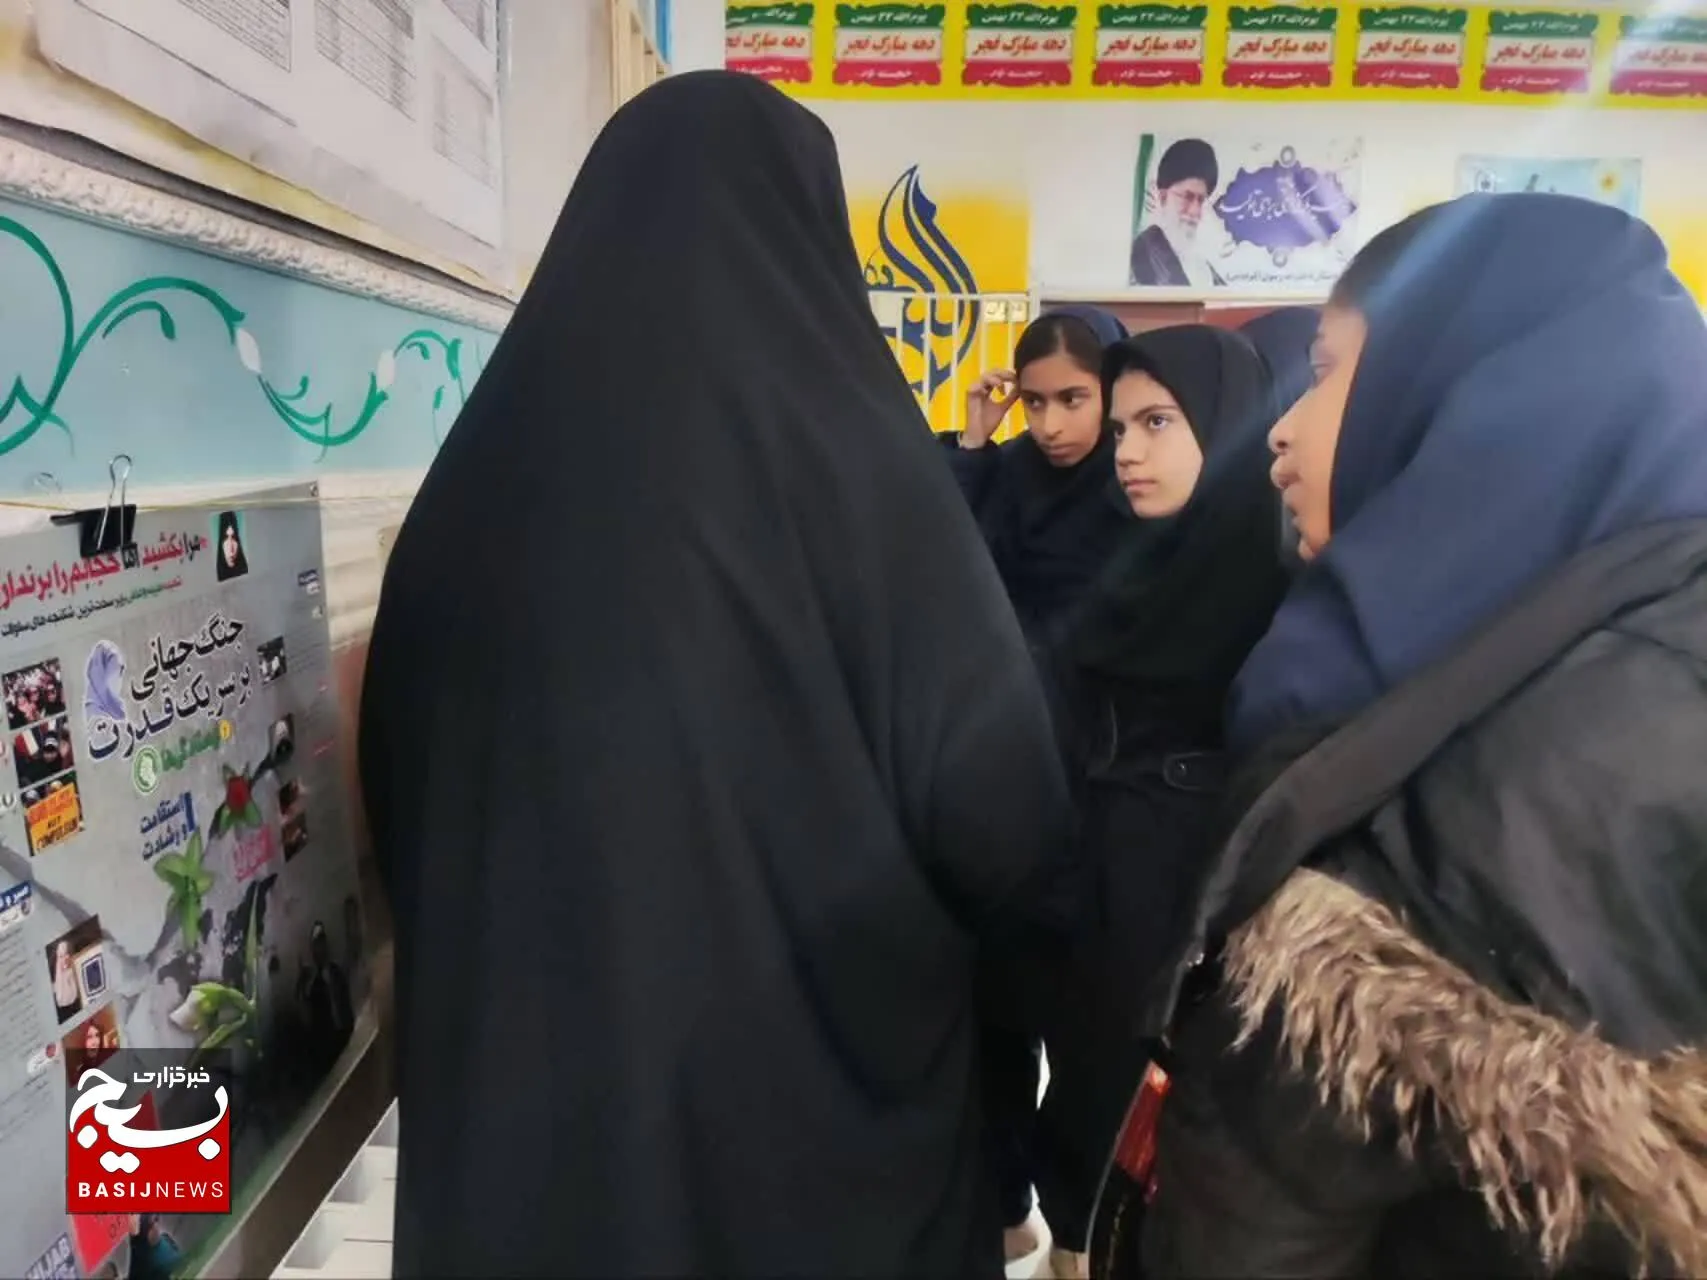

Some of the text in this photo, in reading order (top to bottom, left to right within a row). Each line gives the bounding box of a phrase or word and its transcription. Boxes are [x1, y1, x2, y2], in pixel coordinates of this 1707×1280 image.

[727, 31, 742, 48] فج
[843, 35, 936, 55] دهه مبارک فجر
[972, 35, 1066, 56] دهه مبارک فجر
[1103, 35, 1196, 56] دهه مبارک فجر
[1234, 37, 1328, 58] دهه مبارک فجر
[1362, 38, 1457, 59] دهه مبارک فجر
[1493, 40, 1585, 63] دهه مبارک فجر
[0, 564, 52, 610] برندار
[195, 613, 244, 656] جنگ
[131, 636, 195, 700] جهانی
[176, 673, 212, 717] یک
[89, 684, 174, 760] قدرت
[140, 793, 185, 834] استقامت
